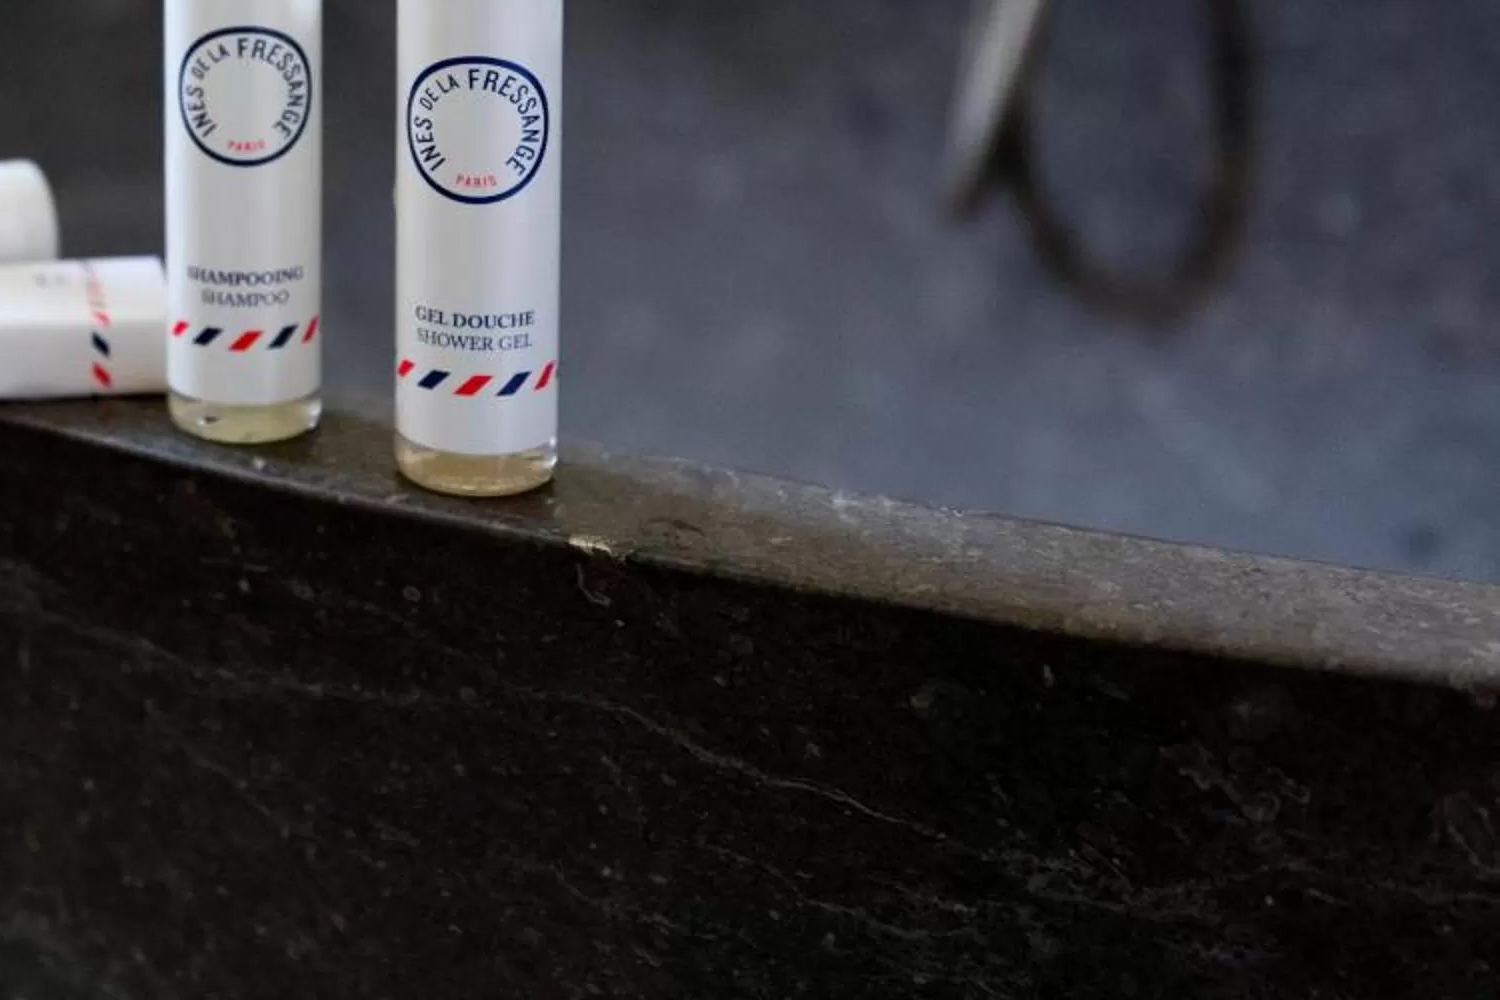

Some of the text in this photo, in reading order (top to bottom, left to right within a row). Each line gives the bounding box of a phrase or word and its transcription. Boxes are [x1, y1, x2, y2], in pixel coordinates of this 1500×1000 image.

[186, 85, 218, 138] INES
[237, 38, 304, 139] FRESSANGE
[413, 115, 446, 172] INES
[467, 68, 540, 177] FRESSANGE
[455, 173, 498, 187] PARIS
[187, 265, 304, 287] SHAMPOOING
[201, 288, 290, 308] SHAMPOO
[415, 305, 536, 329] GEL DOUCHE
[417, 327, 533, 350] SHOWER GEL
